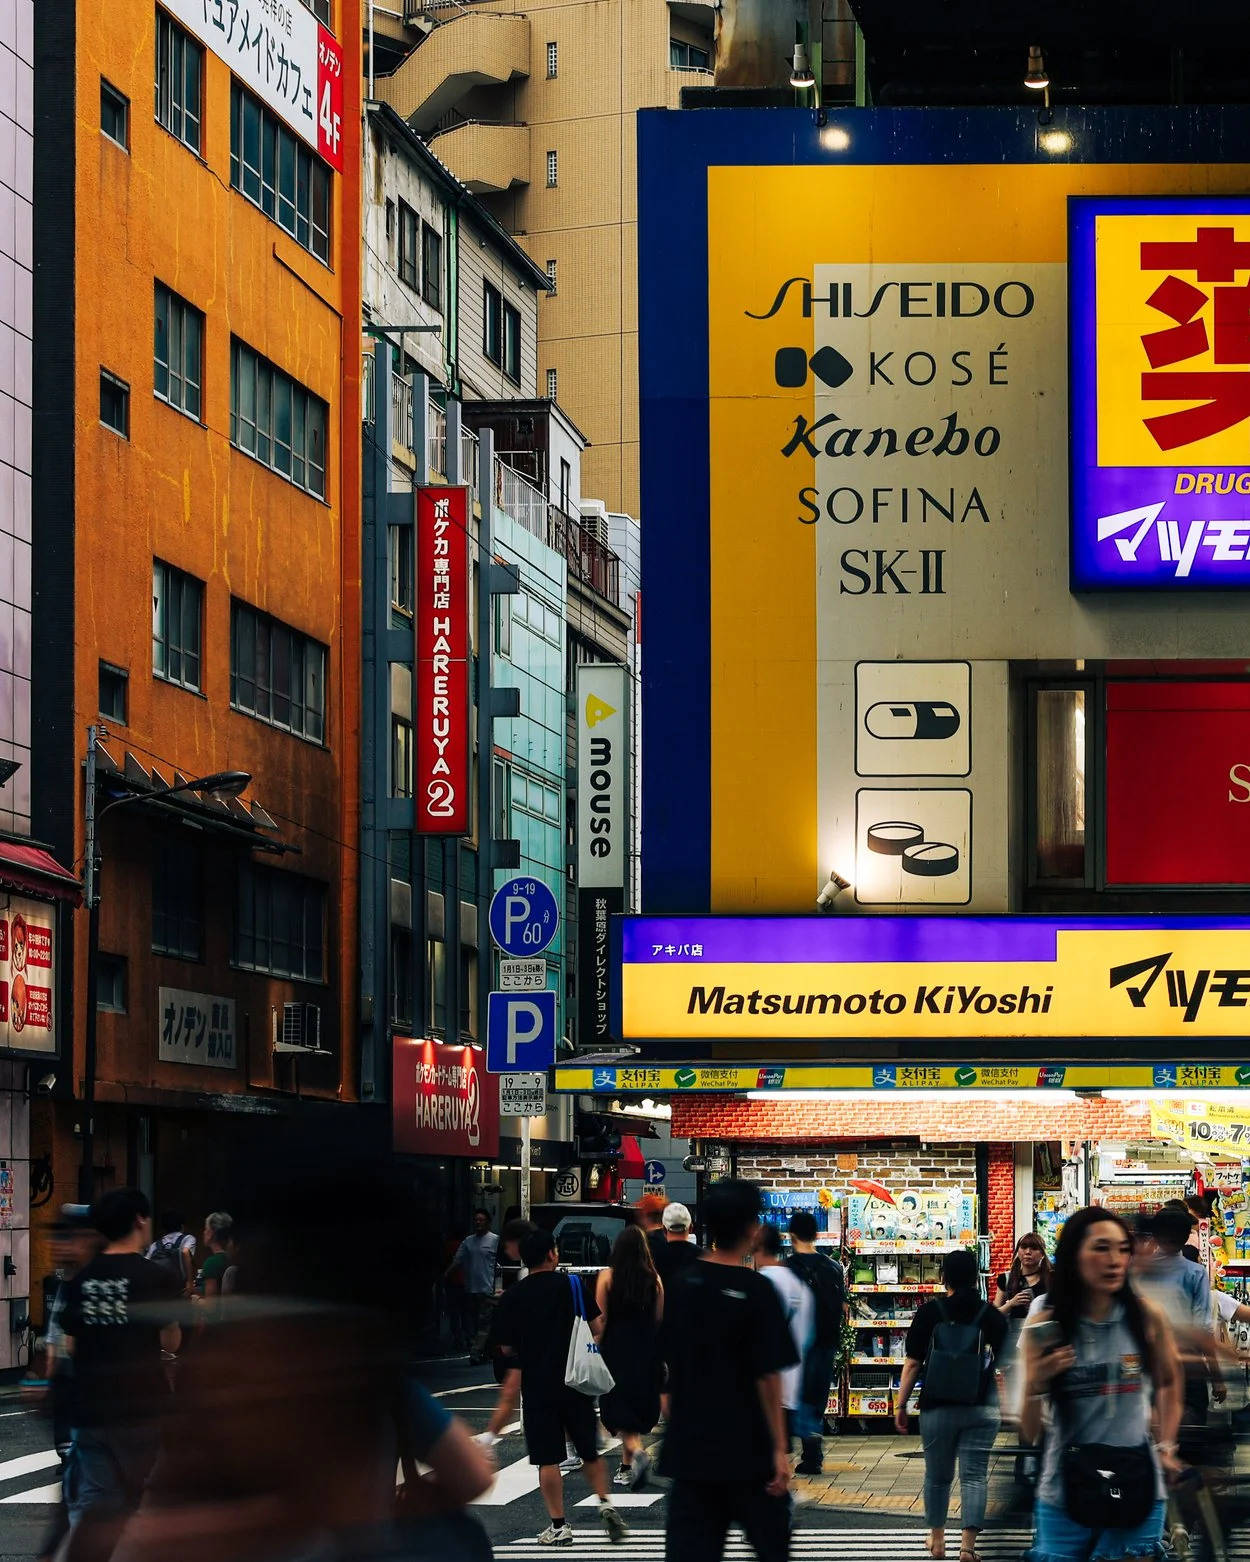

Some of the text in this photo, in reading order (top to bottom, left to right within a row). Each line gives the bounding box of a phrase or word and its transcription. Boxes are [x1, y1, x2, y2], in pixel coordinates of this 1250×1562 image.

[318, 41, 341, 78] オノデン
[319, 79, 341, 155] 4F
[744, 277, 1034, 319] SHISEIDO
[869, 343, 1009, 386] KOSÉ
[781, 411, 1000, 458] Kanebo
[798, 486, 990, 524] SOFINA
[433, 498, 450, 609] ポケカ専門店
[840, 549, 947, 595] SK-II
[432, 617, 451, 775] HARERUYA
[427, 779, 454, 816] 2
[589, 737, 611, 859] mouse
[513, 883, 536, 895] 9-19
[505, 896, 531, 944] P
[522, 923, 541, 944] 60
[543, 910, 550, 923] 分
[595, 899, 607, 1035] 秋葉原ダイレクトショップ
[652, 943, 703, 956] アキバ店
[502, 976, 543, 986] ここから
[687, 985, 1053, 1015] Matsumoto KiYoshi
[507, 1001, 543, 1064] P
[504, 1077, 514, 1088] 19
[535, 1077, 541, 1088] 9
[621, 1069, 660, 1082] 支付宝
[700, 1070, 737, 1079] 微信支付
[900, 1068, 940, 1080] 支付宝
[981, 1068, 1018, 1078] 微信支付
[1181, 1067, 1221, 1079] 支付宝
[416, 1093, 472, 1131] HARERUYA
[503, 1103, 543, 1113] ここから
[770, 1194, 789, 1206] UV
